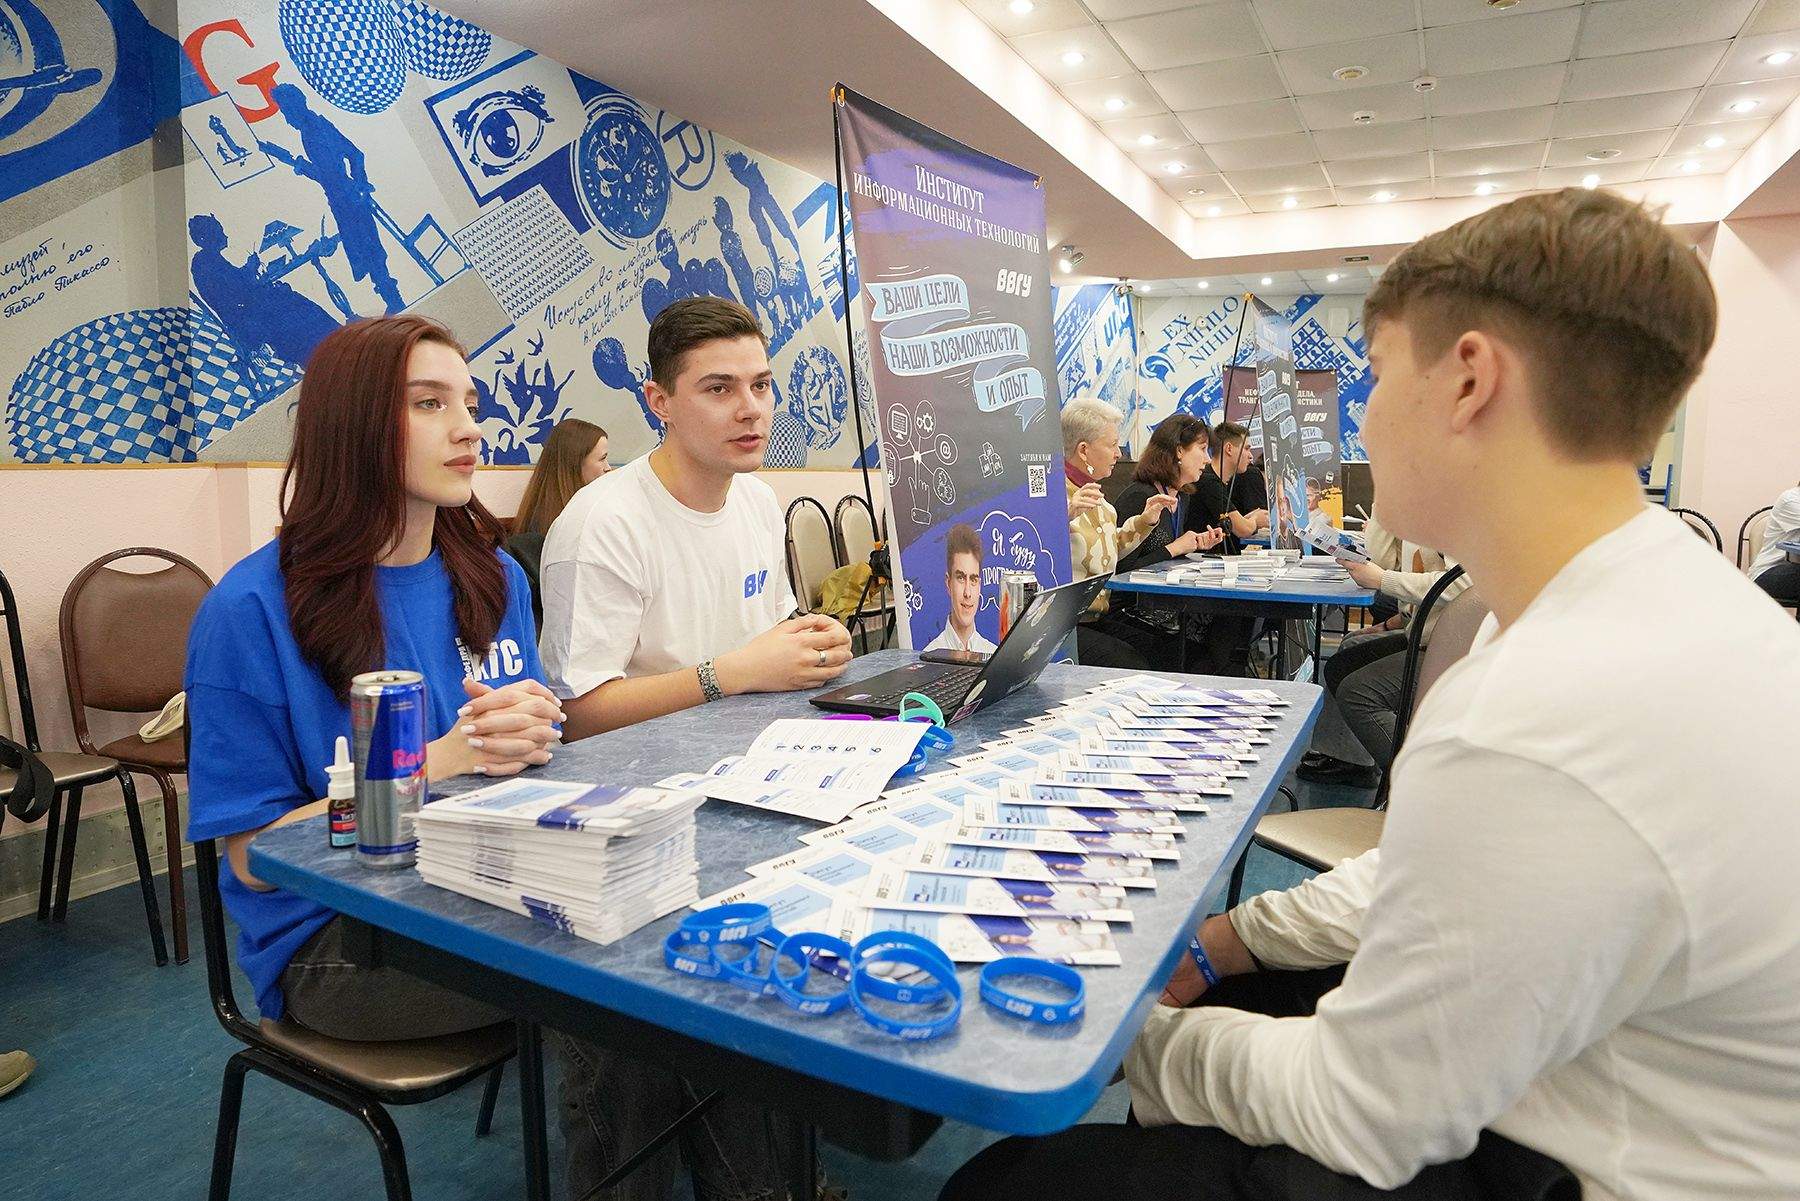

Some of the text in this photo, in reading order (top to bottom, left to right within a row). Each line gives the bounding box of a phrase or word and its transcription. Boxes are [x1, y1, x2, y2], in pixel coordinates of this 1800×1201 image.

[914, 164, 985, 214] ИНСТИТУТ
[853, 172, 1041, 254] ИНФОРМАЦИОННЫХ ТЕХНОЛОГИЙ
[4, 292, 45, 318] Пабло
[882, 281, 962, 315] ВАШИ ЦЕЛИ
[1160, 313, 1192, 341] EX
[888, 327, 1020, 370] НАШИ ВОЗМОЖНОСТИ
[1188, 325, 1239, 368] NIHIL
[986, 373, 1030, 406] И ОПЫТ
